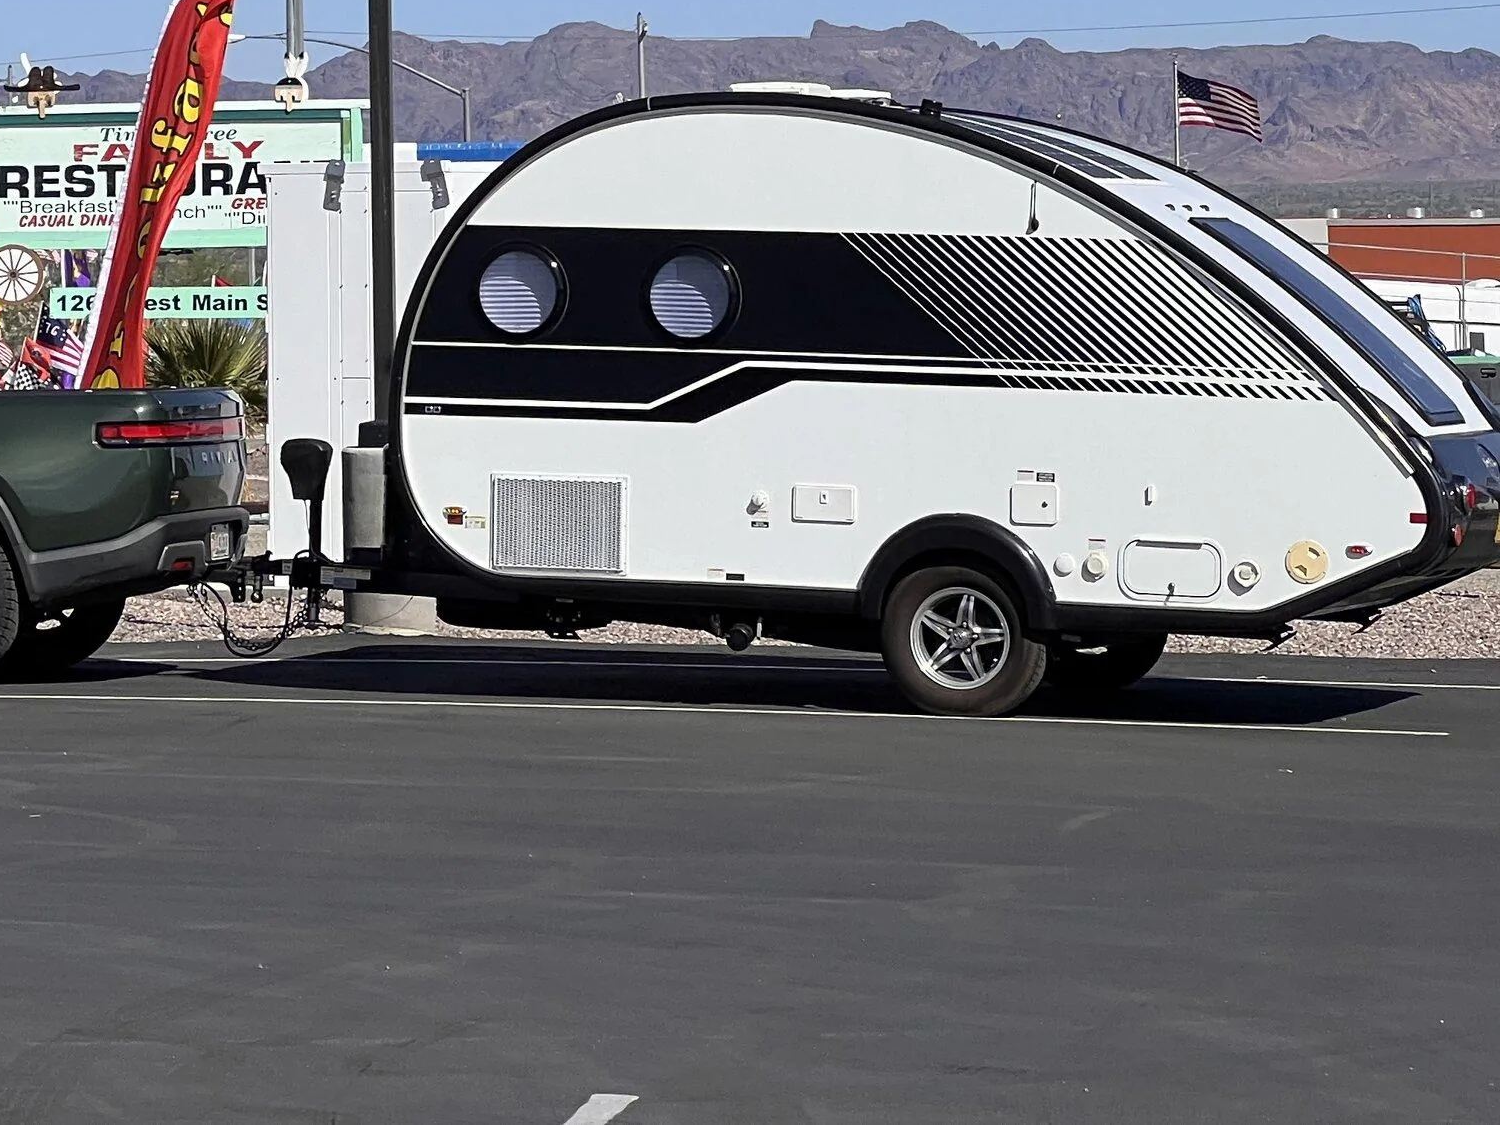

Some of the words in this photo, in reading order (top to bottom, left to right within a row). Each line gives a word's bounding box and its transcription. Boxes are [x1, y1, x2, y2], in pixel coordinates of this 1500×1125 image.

[101, 127, 135, 142] Tim
[205, 128, 237, 141] ree
[73, 140, 264, 162] FALY
[231, 197, 267, 210] GRE
[19, 214, 75, 228] CASUAL
[79, 213, 114, 227] DINI
[57, 295, 97, 312] 126
[145, 294, 181, 311] est
[193, 293, 248, 311] Main
[256, 295, 268, 311] S
[45, 322, 60, 337] 76
